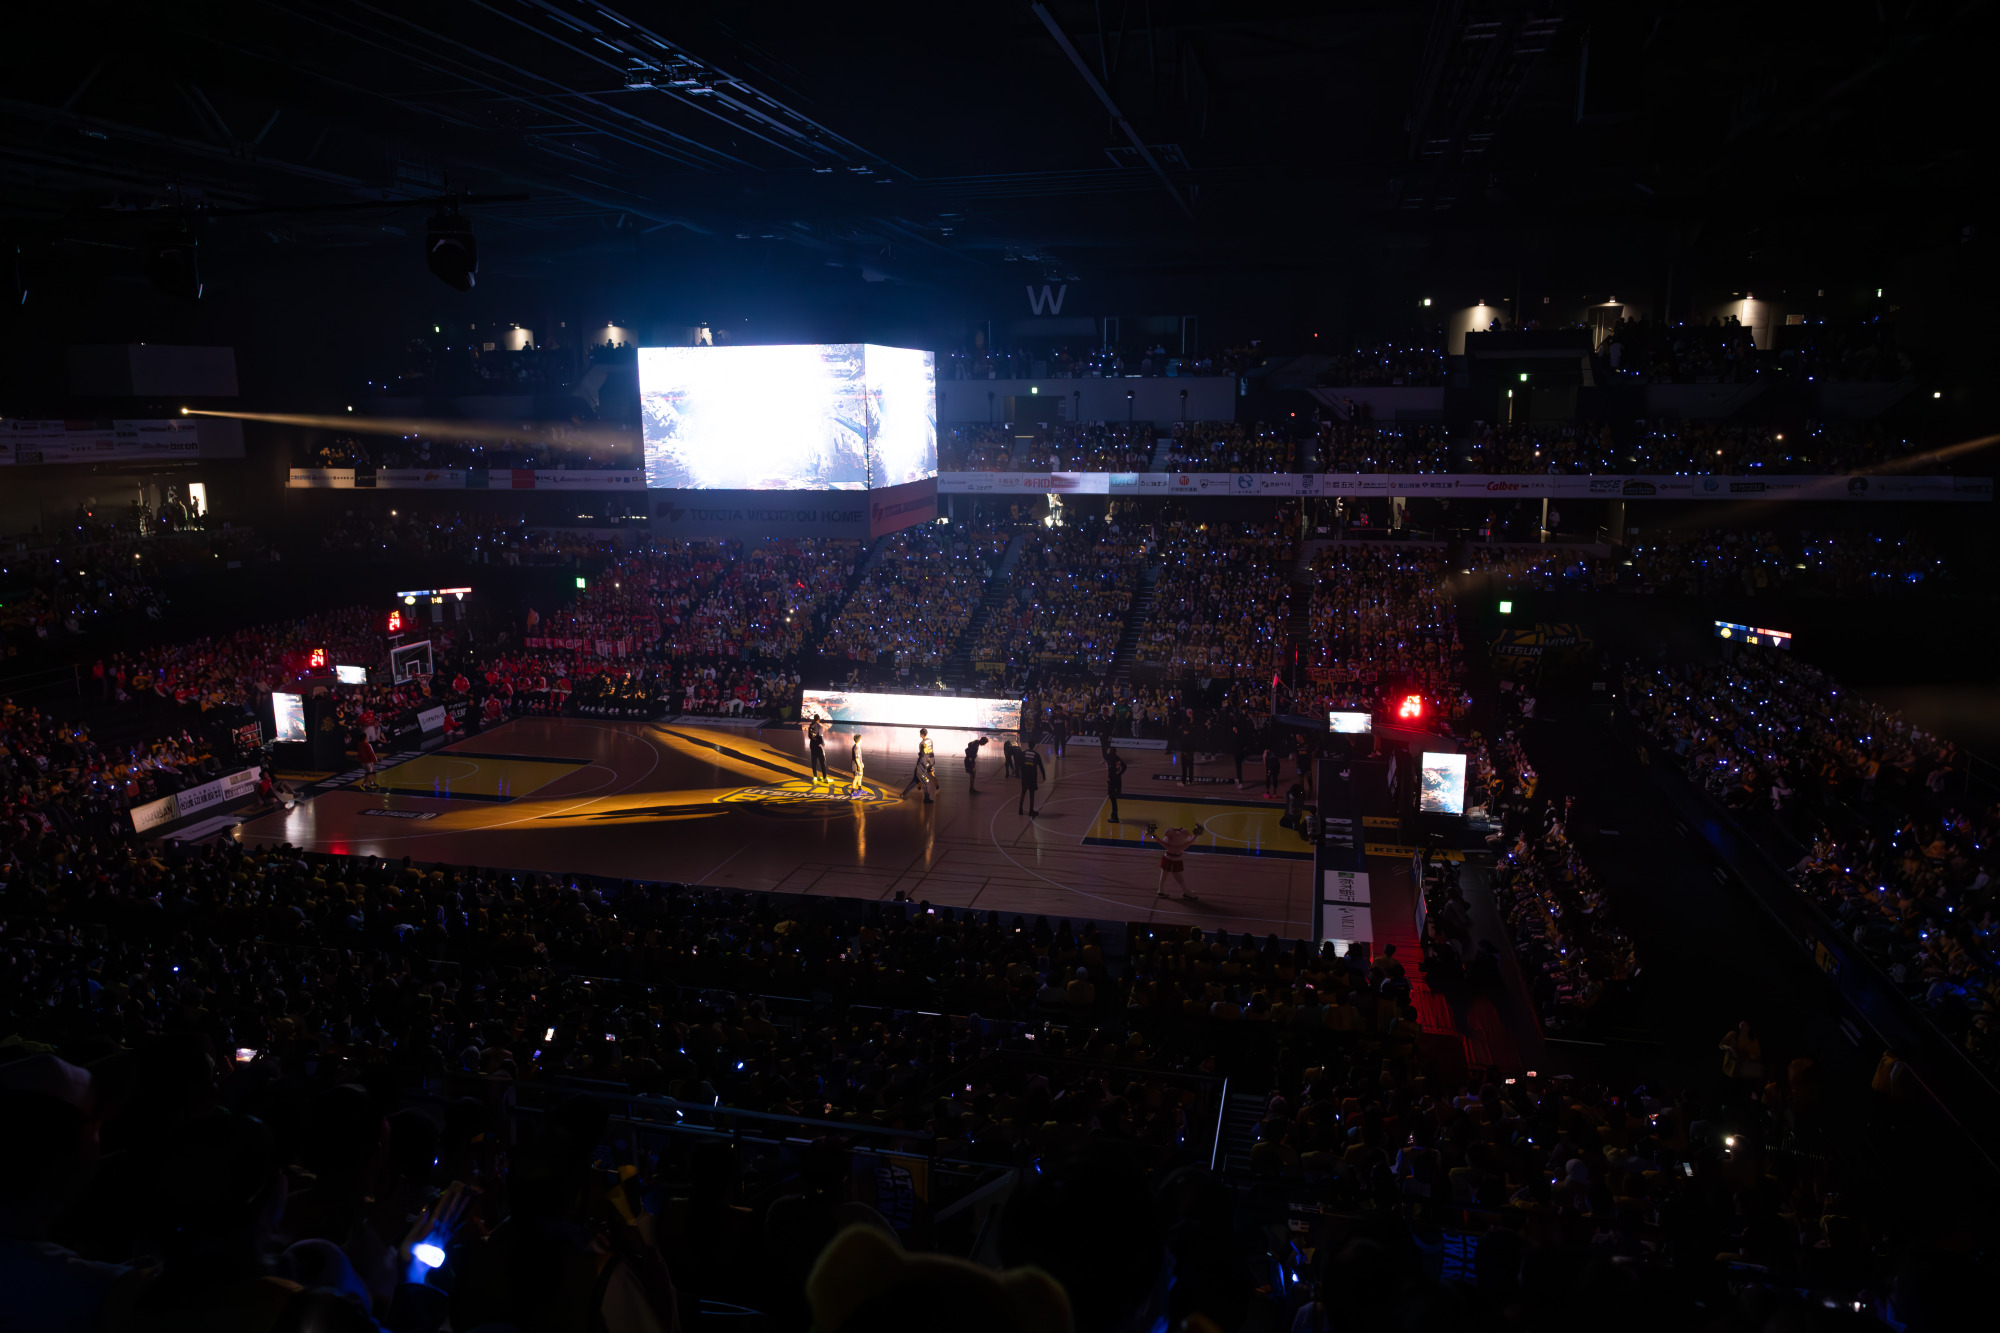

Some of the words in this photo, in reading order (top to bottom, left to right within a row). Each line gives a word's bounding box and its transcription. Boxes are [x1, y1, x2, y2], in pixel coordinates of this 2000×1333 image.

[1026, 284, 1067, 315] W
[1486, 480, 1519, 491] Calbee
[690, 508, 743, 521] TOYOTA
[821, 510, 863, 523] HOME
[389, 618, 400, 631] 24
[311, 655, 324, 667] 24
[1400, 702, 1421, 717] 24
[872, 1168, 896, 1223] OGAW
